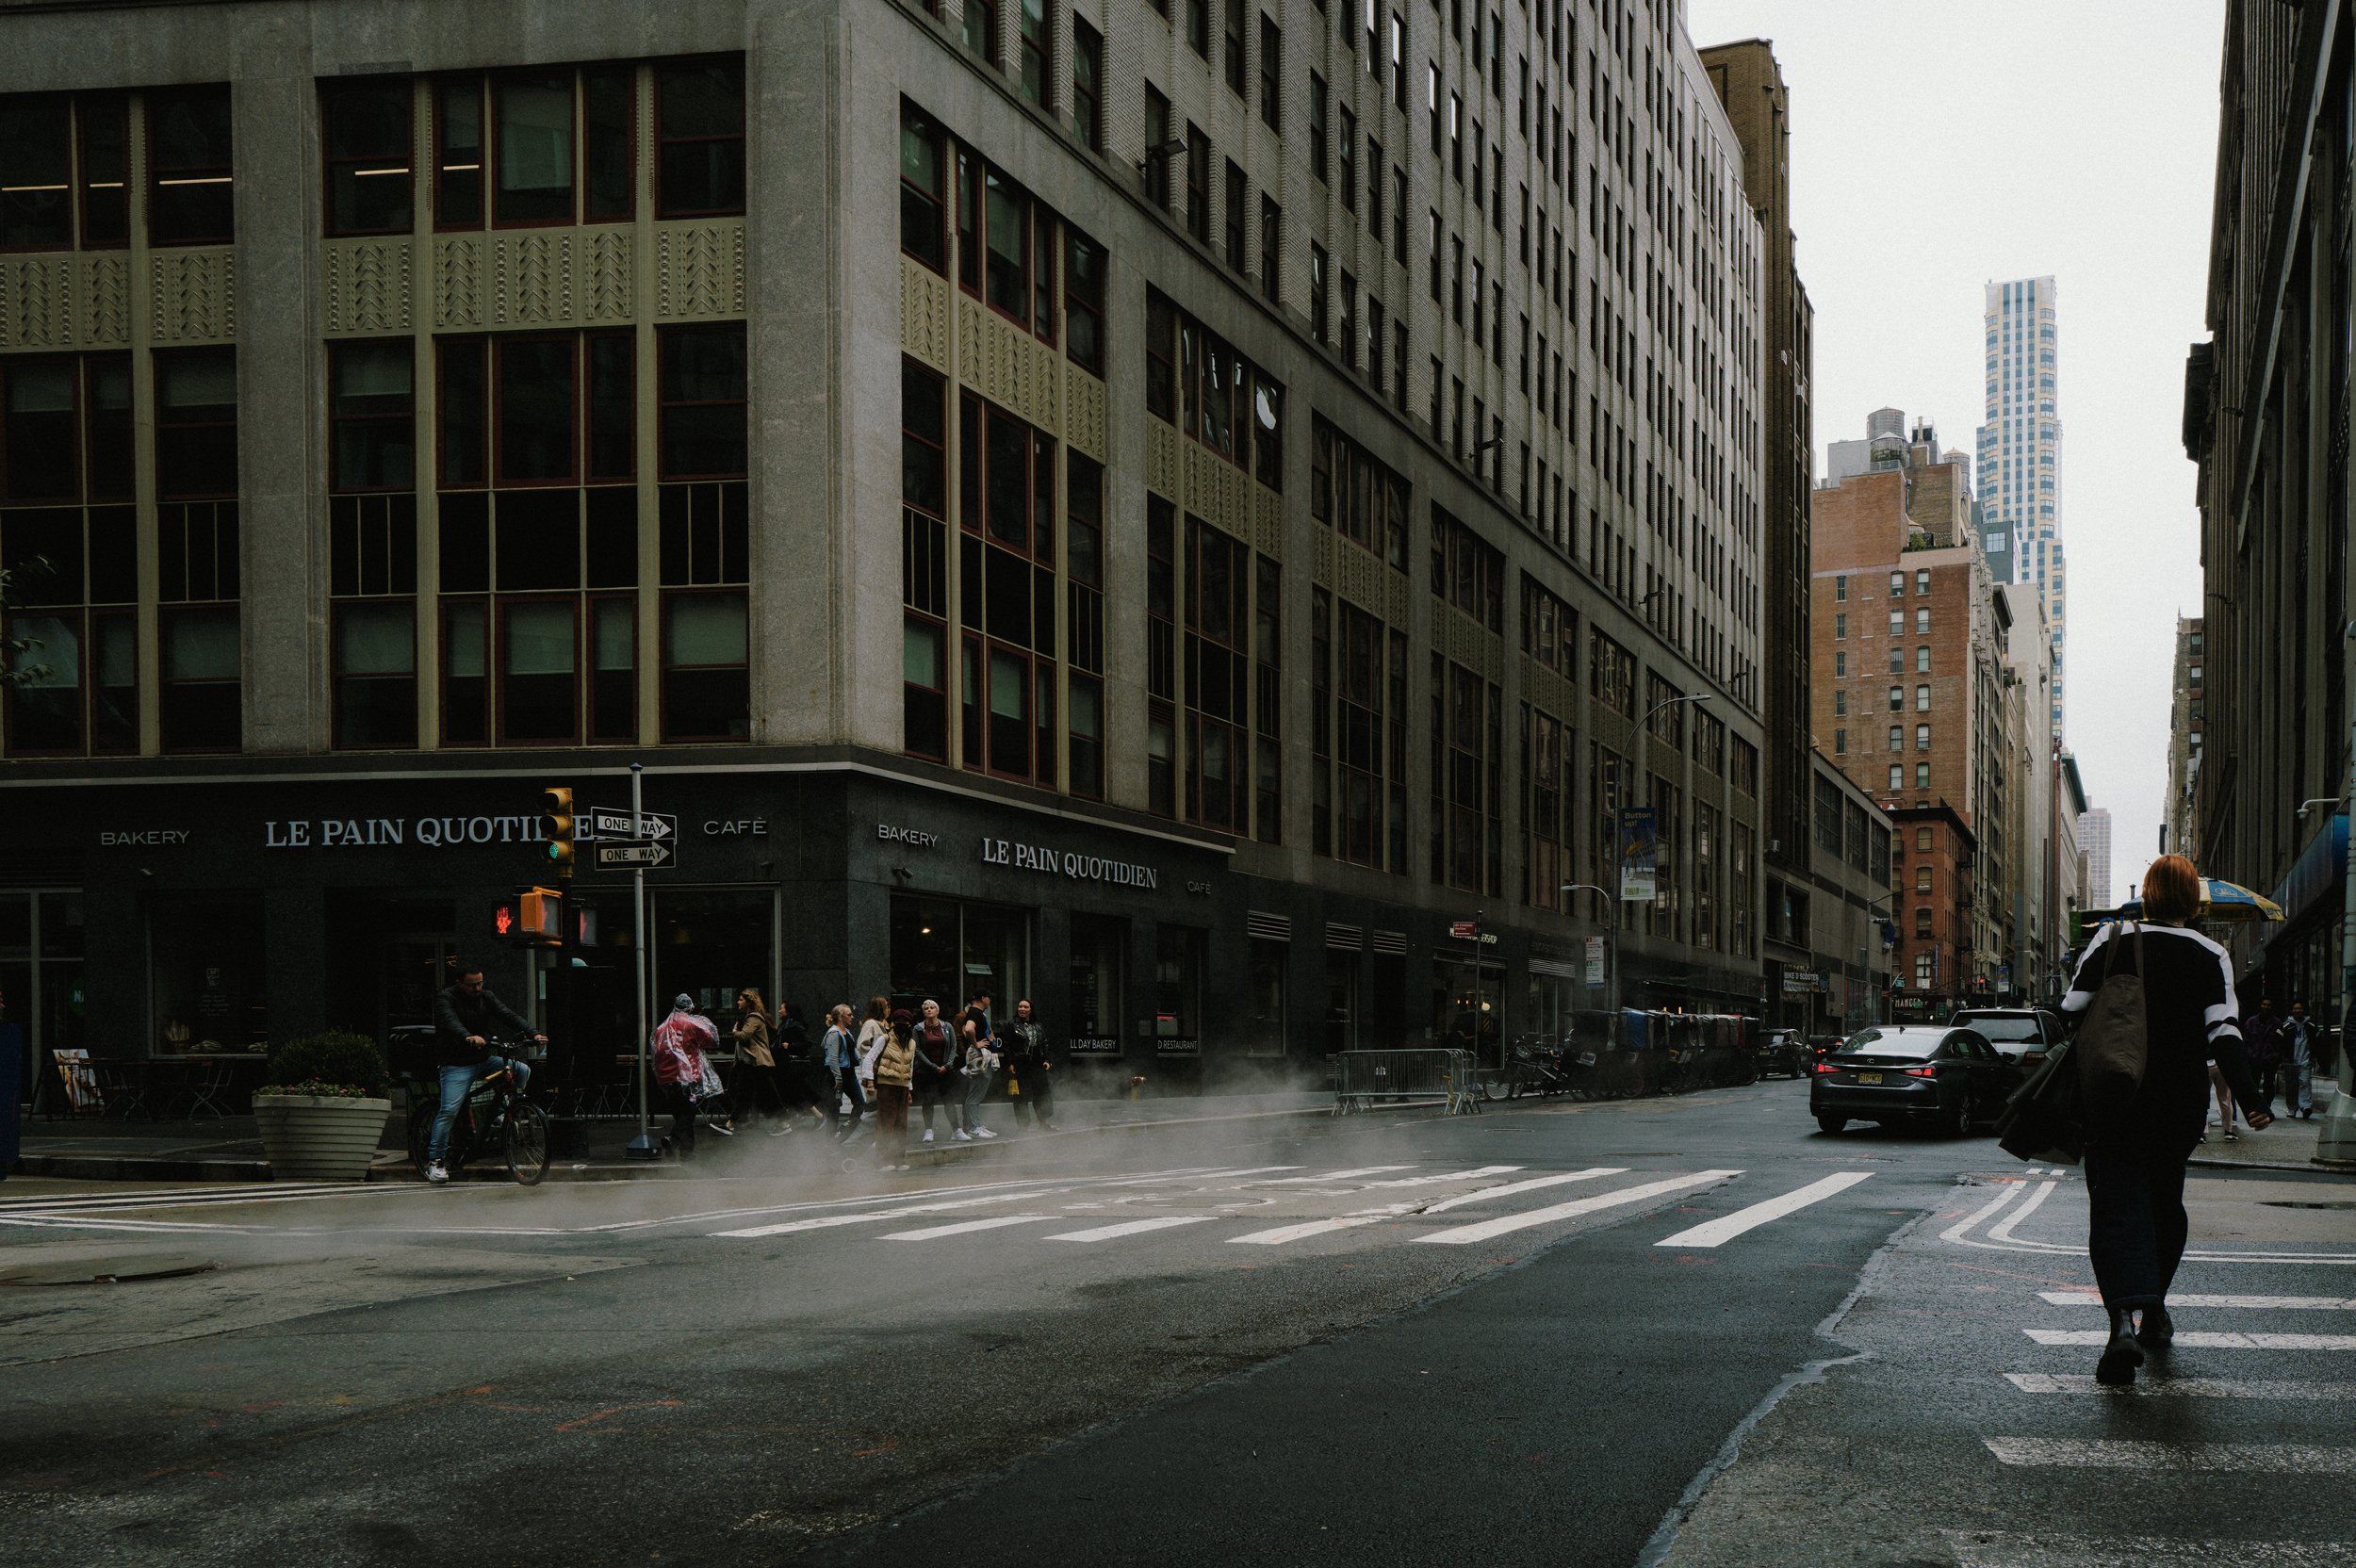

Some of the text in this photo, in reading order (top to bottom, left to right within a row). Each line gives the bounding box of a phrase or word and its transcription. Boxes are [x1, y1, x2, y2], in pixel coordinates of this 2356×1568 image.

[265, 814, 607, 848] LE PAIN QUOTIE
[604, 817, 663, 835] ONE WAY
[100, 829, 191, 847] BAKERY
[878, 824, 939, 848] BAKERY
[606, 848, 663, 861] ONE WAY
[983, 837, 1157, 890] LE PAIN QUOTIDIEN
[1078, 1038, 1092, 1050] DAY
[1091, 1038, 1117, 1050] BAKERY
[1163, 1039, 1199, 1050] RESTAURANT
